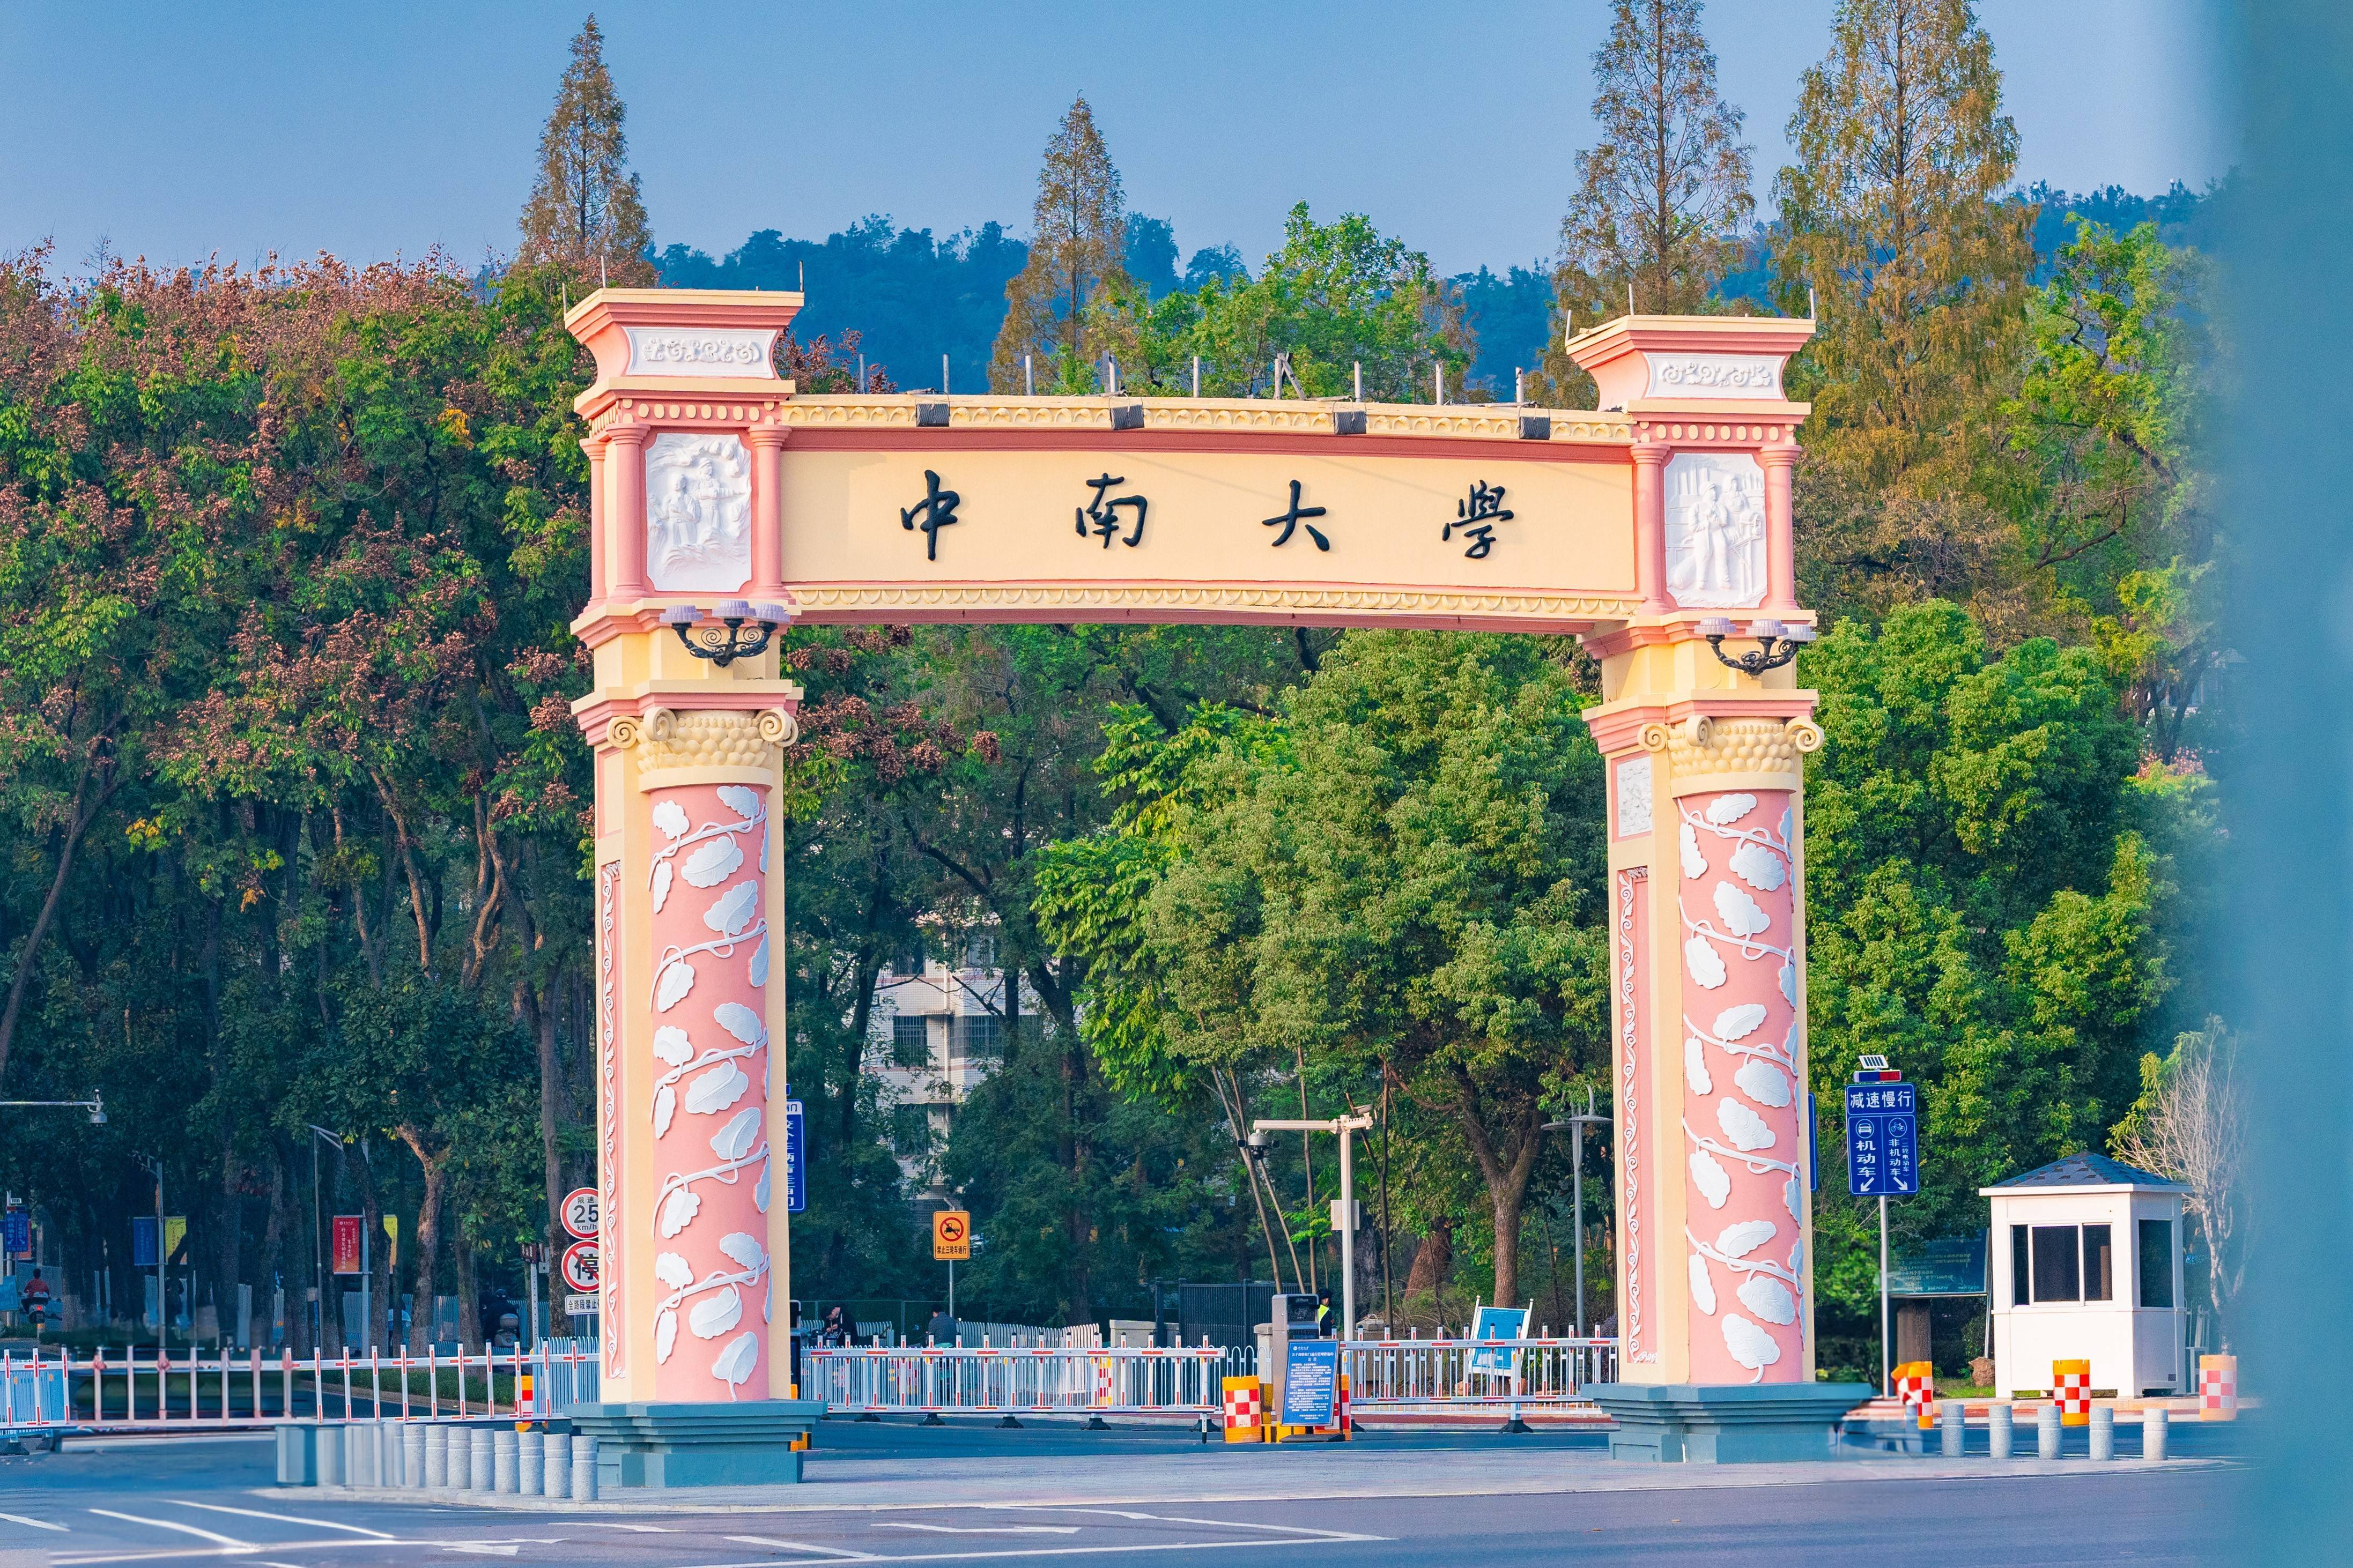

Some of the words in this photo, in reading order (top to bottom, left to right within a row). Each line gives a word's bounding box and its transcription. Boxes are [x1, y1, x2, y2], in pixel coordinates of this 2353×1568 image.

[1850, 1090, 1912, 1109] 减速慢行
[1855, 1140, 1876, 1177] 机动车
[1889, 1138, 1901, 1176] 非机动车
[578, 1196, 595, 1204] 限速
[574, 1205, 598, 1223] 25
[937, 1245, 967, 1254] 禁止三轮车通行
[574, 1253, 599, 1280] 停
[568, 1299, 599, 1311] 全路段禁止
